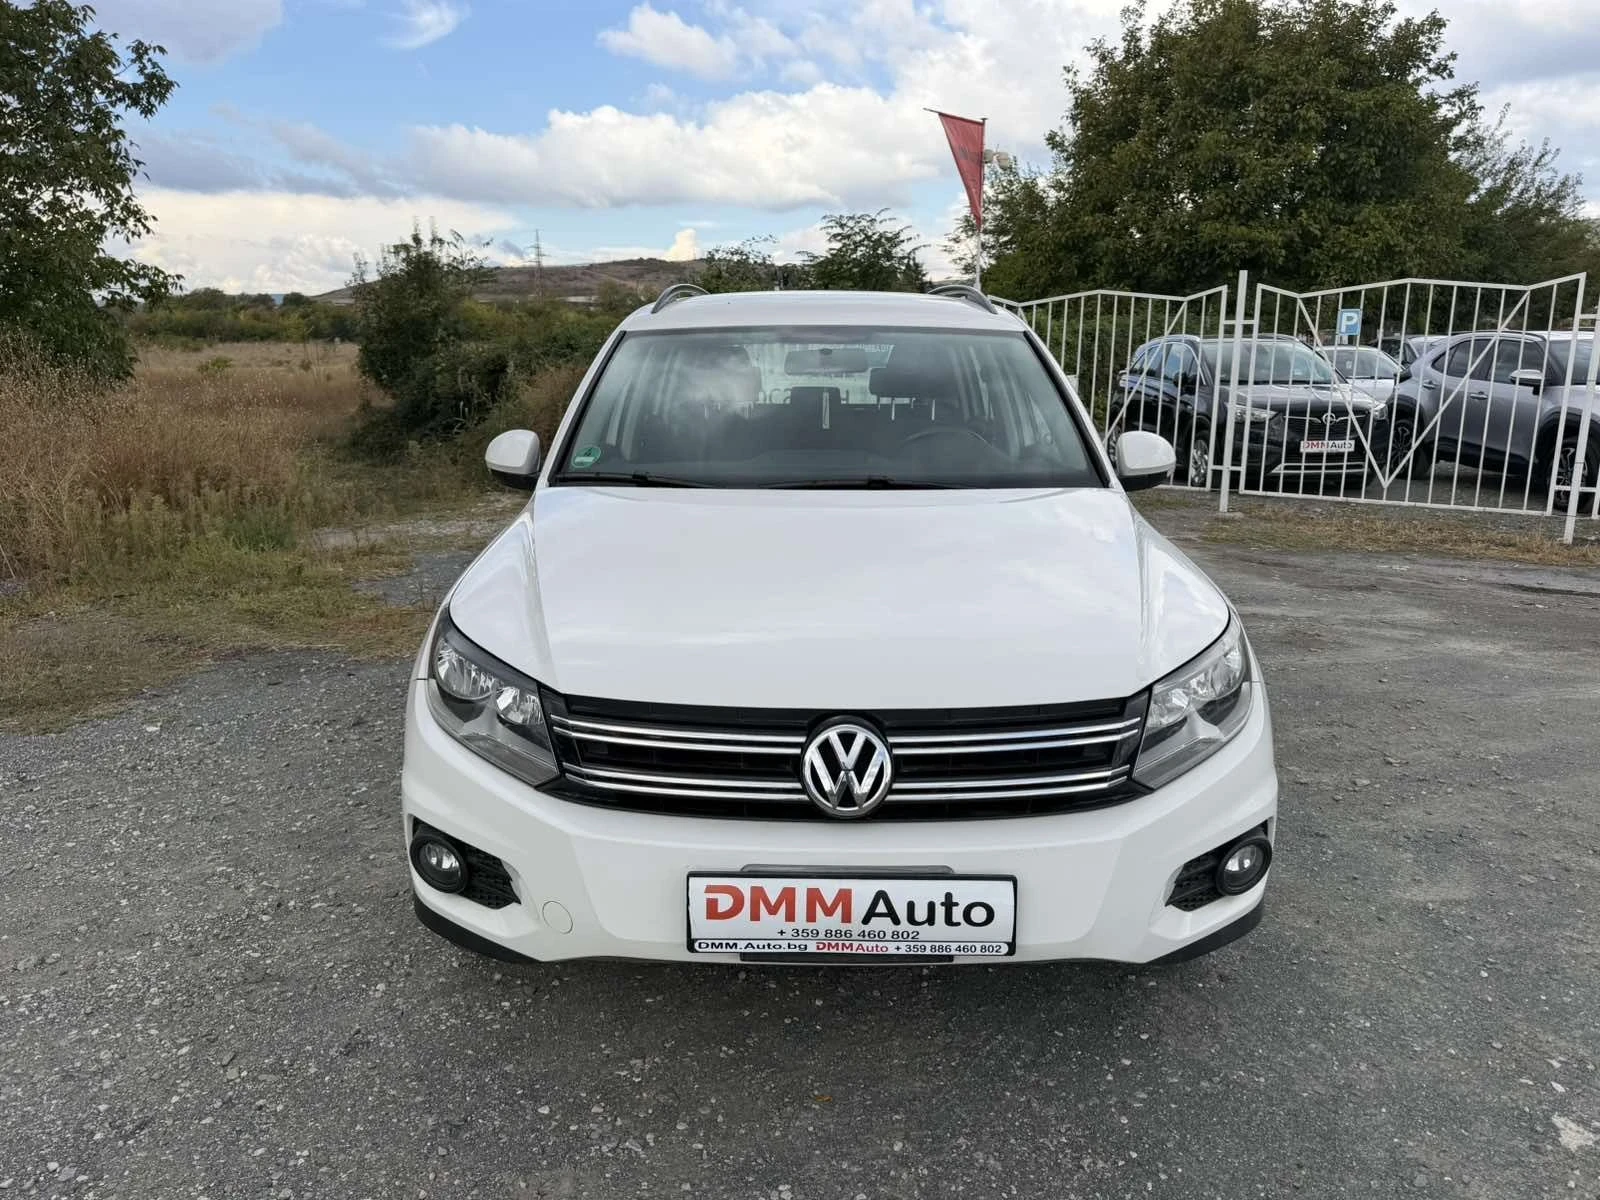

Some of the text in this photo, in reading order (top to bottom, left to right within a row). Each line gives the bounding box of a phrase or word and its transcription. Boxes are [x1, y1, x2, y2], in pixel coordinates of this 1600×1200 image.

[1341, 312, 1358, 333] P
[804, 725, 892, 815] VW
[791, 928, 819, 938] 359
[824, 929, 853, 939] 886
[857, 930, 886, 940] 460
[890, 930, 920, 940] 802
[697, 942, 808, 951] DMM.Auto.bg
[904, 944, 927, 953] 359
[929, 944, 952, 953] 886
[955, 944, 977, 954] 460
[980, 944, 1002, 954] 802
